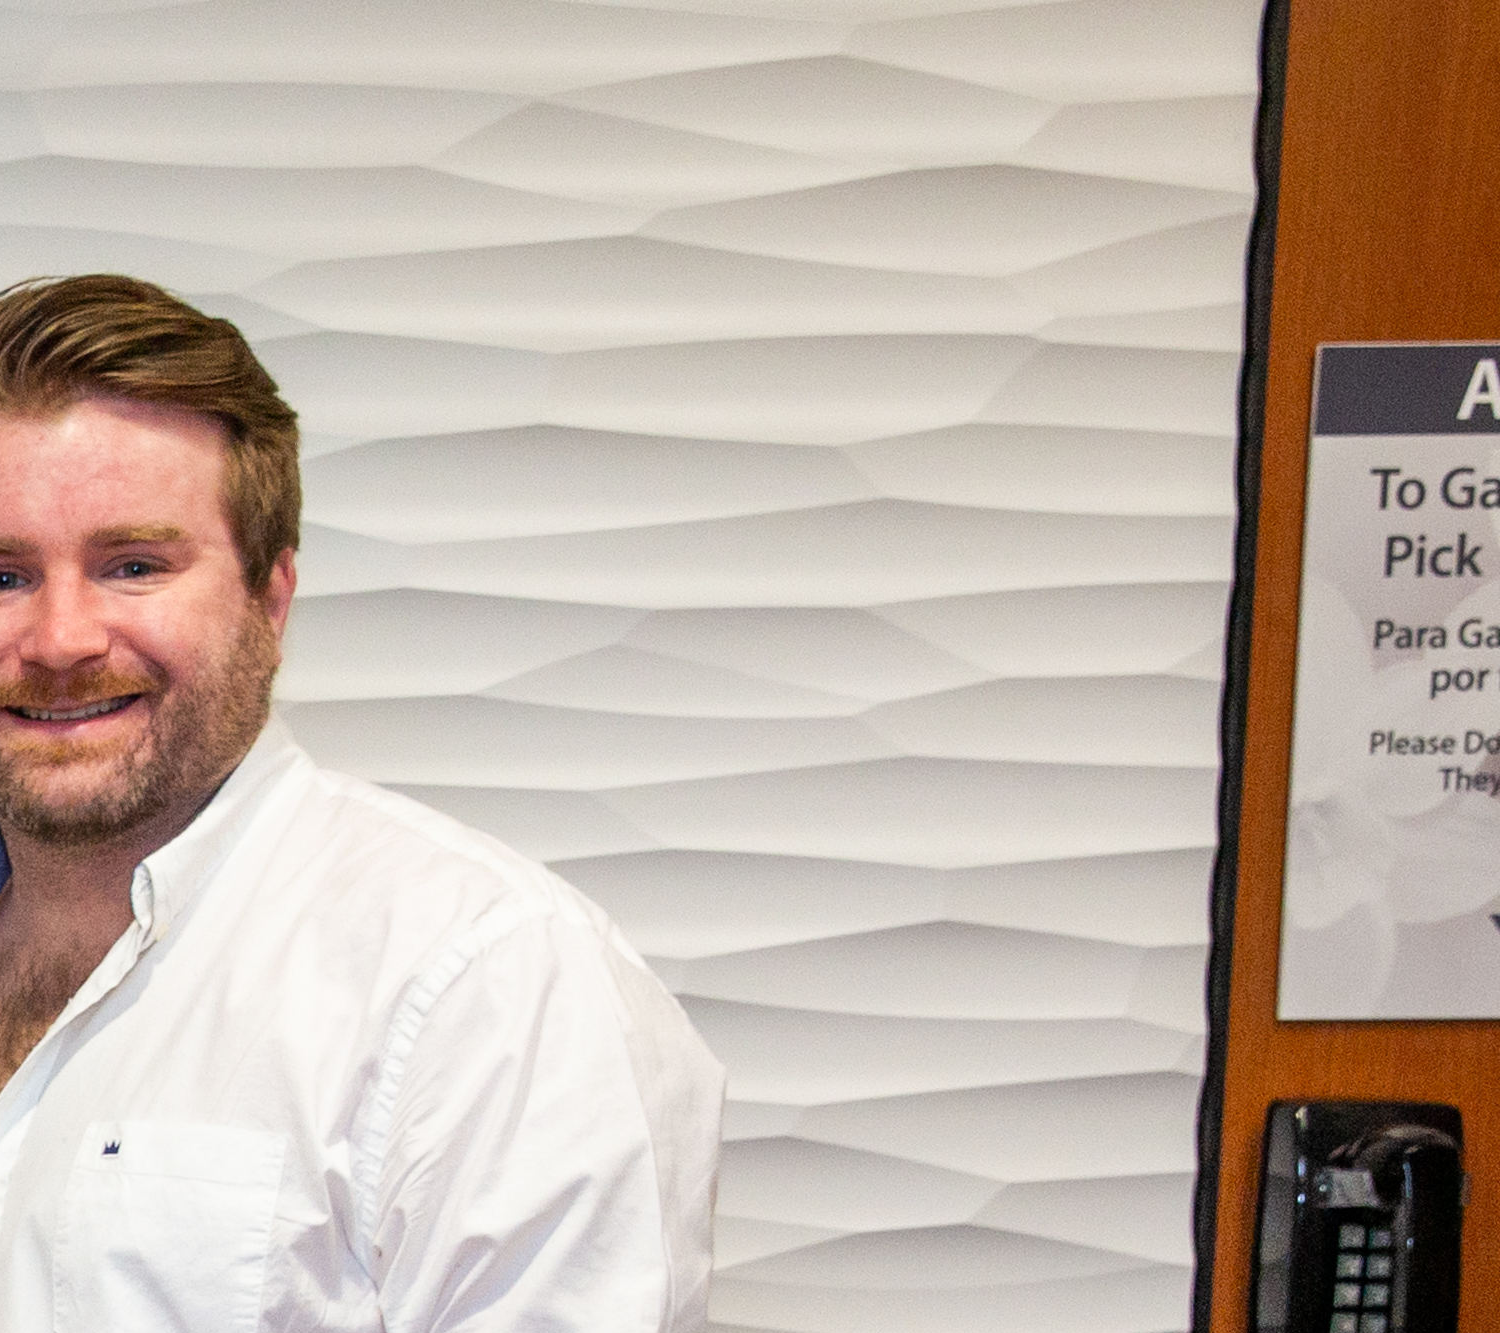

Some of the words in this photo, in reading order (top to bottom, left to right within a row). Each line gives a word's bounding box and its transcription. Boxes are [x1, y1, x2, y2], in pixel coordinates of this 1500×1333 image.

[1371, 467, 1426, 510] To
[1385, 533, 1482, 578] Pick
[1374, 619, 1447, 651] Para
[1430, 669, 1490, 698] por
[1369, 731, 1456, 756] Please
